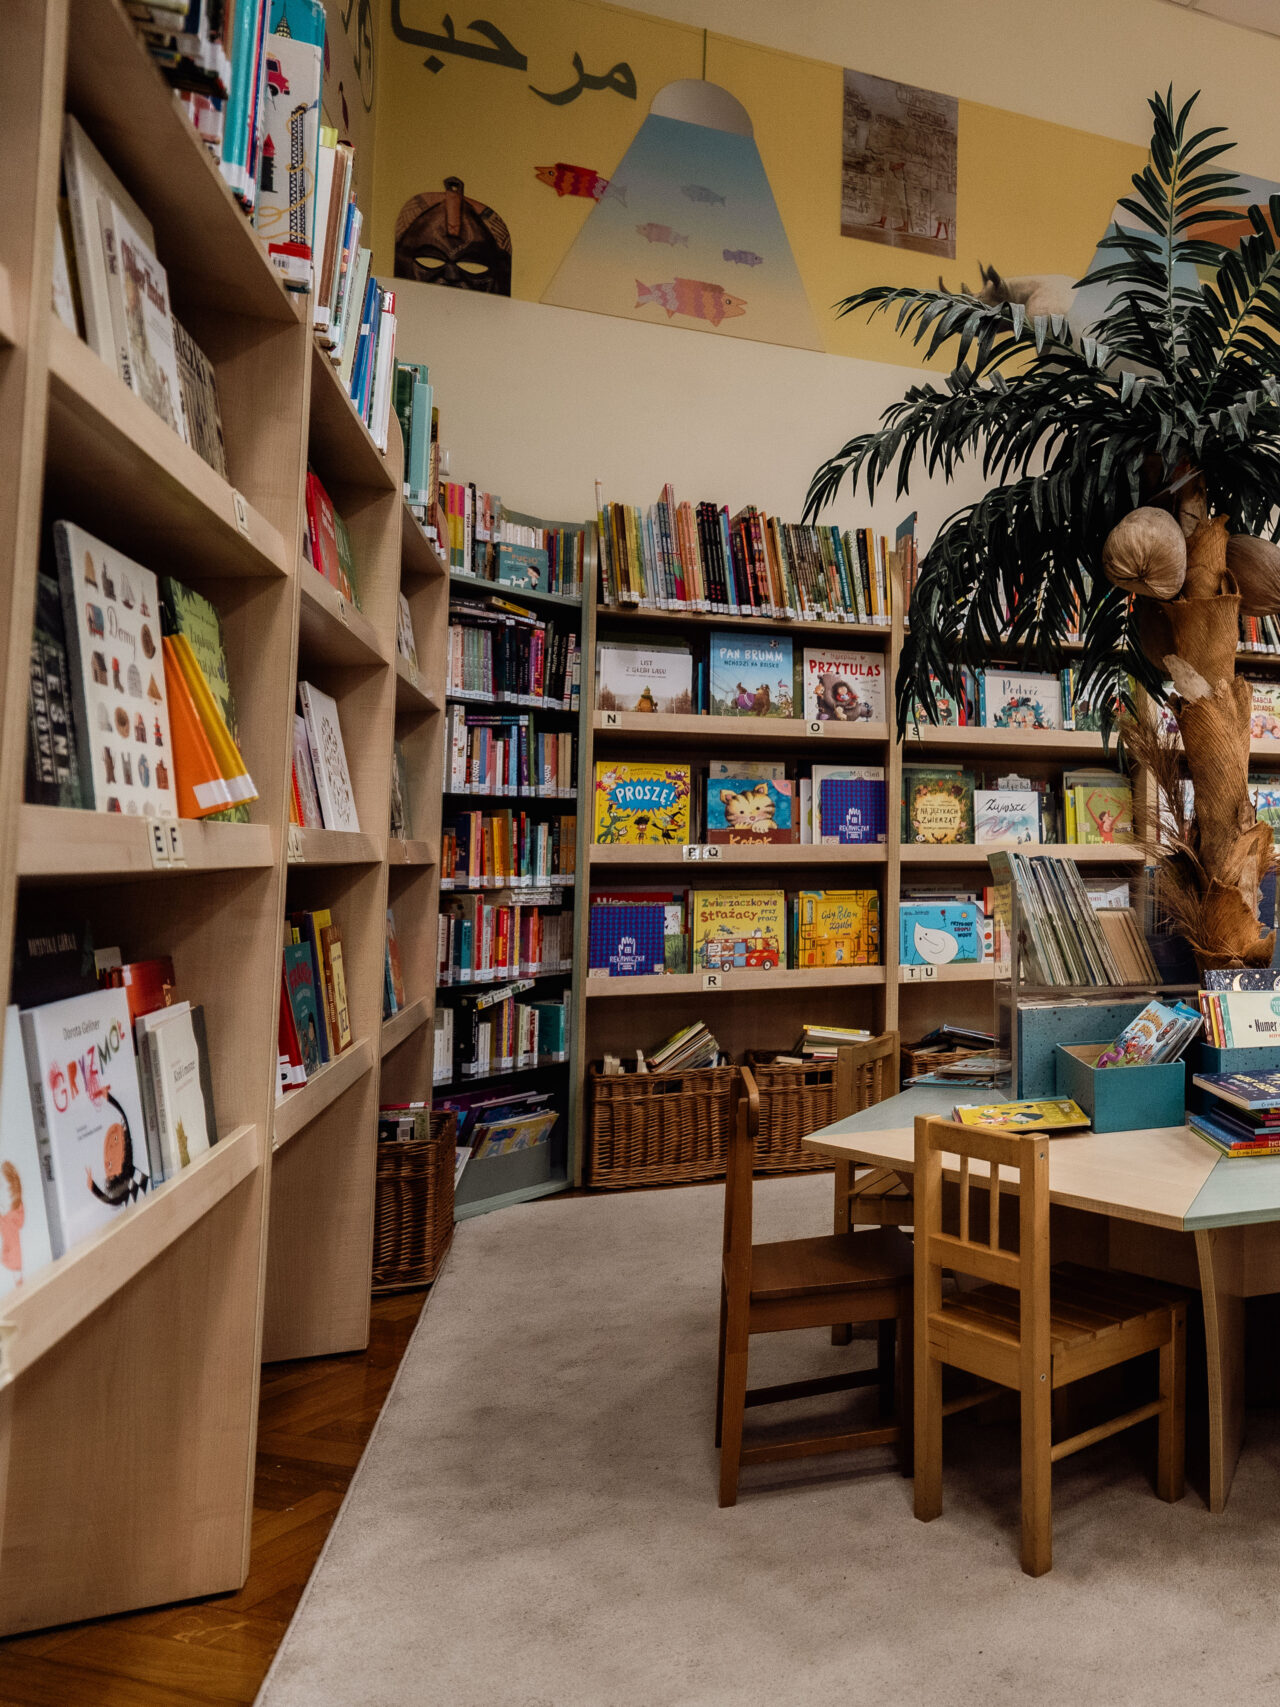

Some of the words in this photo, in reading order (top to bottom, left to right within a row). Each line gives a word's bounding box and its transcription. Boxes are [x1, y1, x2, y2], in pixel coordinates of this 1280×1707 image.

[720, 647, 740, 659] PAN
[745, 649, 783, 661] BRUMM
[809, 659, 881, 677] PRZYTULAS
[606, 714, 617, 725] N
[811, 722, 821, 732] O
[616, 786, 676, 805] PROSZĘ!
[153, 826, 163, 853] E
[170, 826, 177, 853] F
[709, 847, 718, 857] Q
[702, 898, 777, 908] Zwierzaczkowie
[700, 909, 758, 923] Strażacy
[908, 968, 916, 977] T
[925, 968, 933, 977] U
[708, 976, 717, 985] R
[1254, 1019, 1278, 1032] Numer
[52, 1019, 126, 1113] GRYZMOŁ
